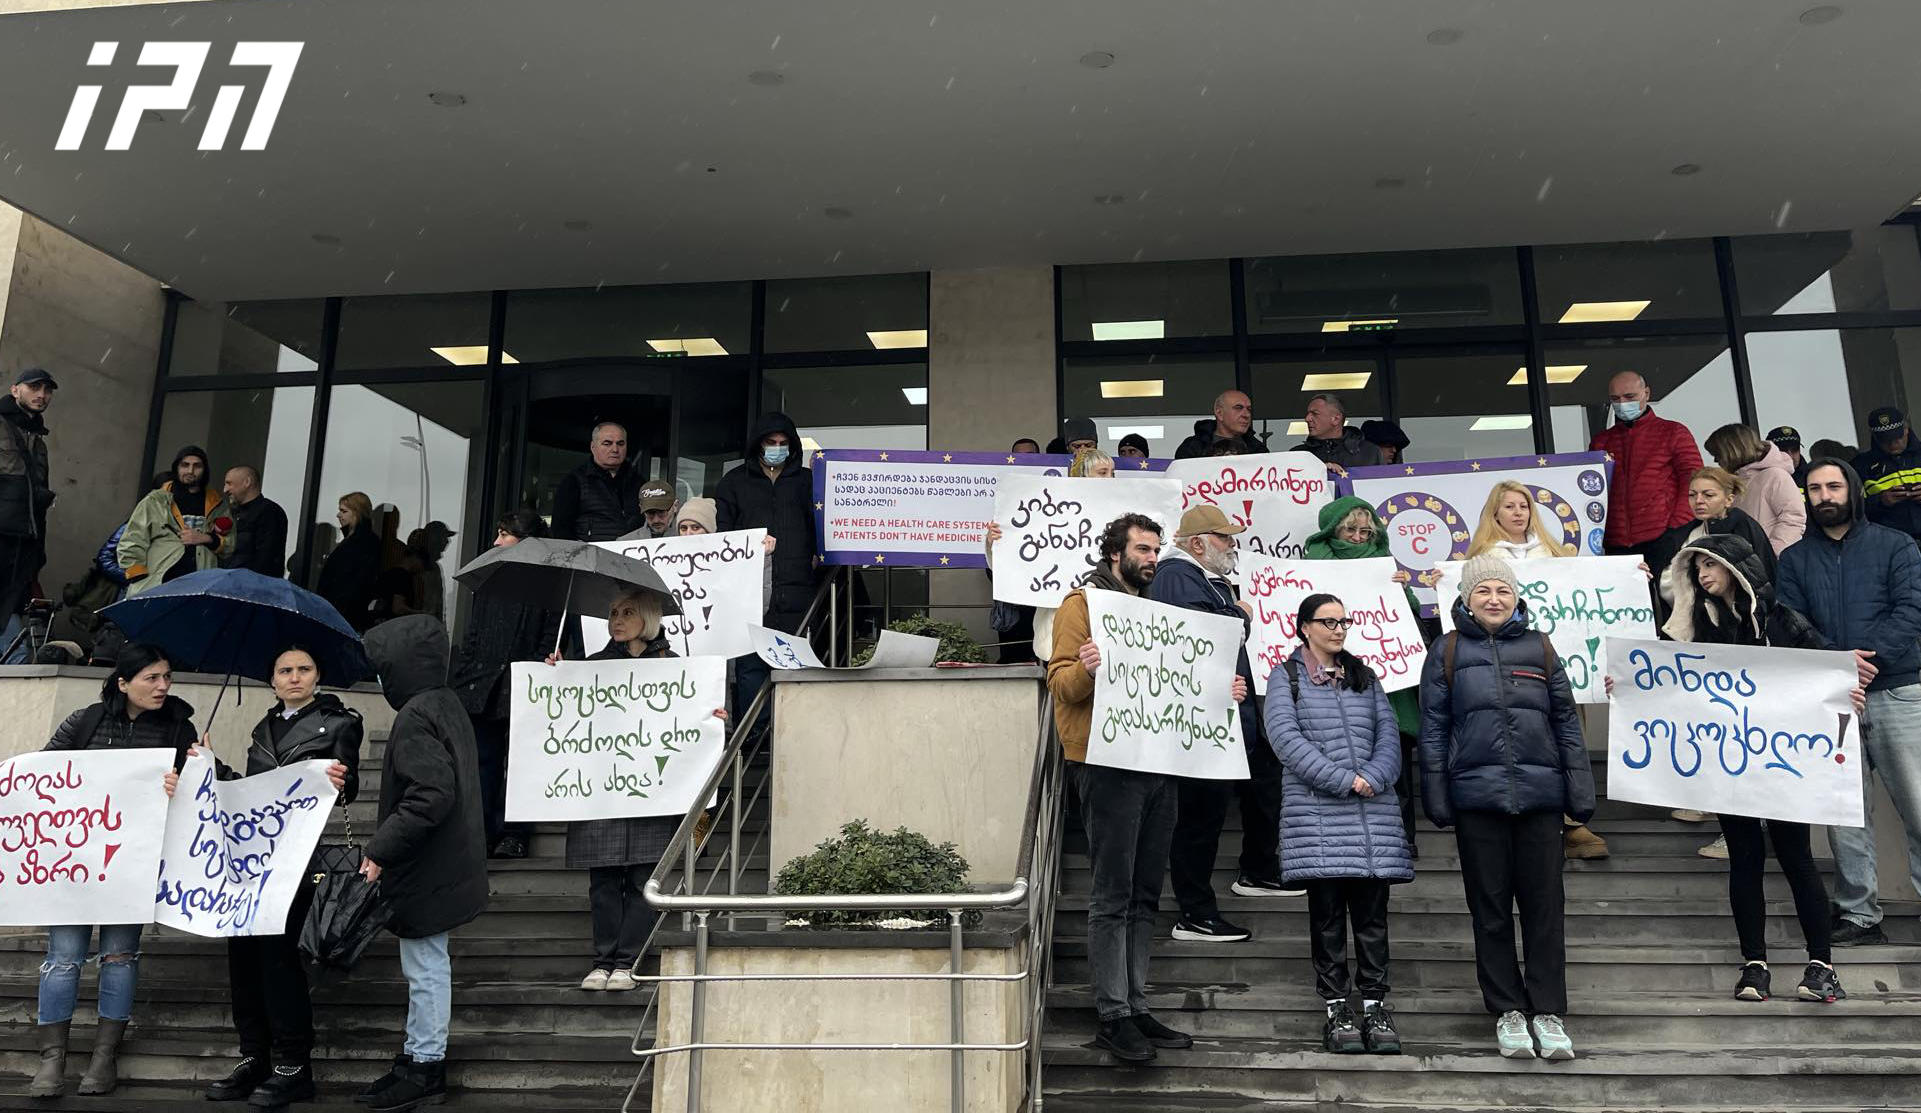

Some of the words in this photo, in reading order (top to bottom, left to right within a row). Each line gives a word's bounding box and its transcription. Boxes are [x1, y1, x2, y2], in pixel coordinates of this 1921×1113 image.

[834, 485, 866, 494] სადაც
[867, 486, 925, 495] პაციენტებს
[927, 487, 971, 496] წამლები
[973, 488, 987, 497] არ
[836, 472, 859, 481] ჩვენ
[861, 473, 917, 483] გვჭირდება
[919, 475, 971, 484] ჯანდაცვის
[973, 476, 997, 485] სისტ
[834, 498, 897, 507] სანატრელი!
[1011, 488, 1082, 528] კიბო
[833, 530, 878, 540] PATIENTS
[879, 531, 908, 541] DON'T
[910, 532, 934, 541] HAVE
[936, 533, 982, 542] MEDICINE
[834, 518, 849, 527] WE
[851, 518, 877, 527] NEED
[879, 519, 886, 528] A
[887, 519, 924, 528] HEALTH
[926, 520, 951, 529] CARE
[1398, 523, 1437, 536] STOP
[1412, 536, 1429, 555] C
[1030, 564, 1061, 592] არ
[1102, 613, 1214, 664] დაგვეხმარეთ
[528, 669, 697, 720] სიცოცხლისთვის
[1107, 649, 1201, 699] სიცოცხლის
[1629, 649, 1757, 716] მინდა
[543, 718, 652, 760] ბრძოლის
[660, 716, 701, 752] დრო
[1102, 694, 1235, 752] გადასარჩენად!
[1622, 705, 1852, 778] ვიცოცხლო!
[0, 760, 83, 804] ძოლას
[544, 768, 592, 798] არის
[603, 755, 670, 798] ახლა!
